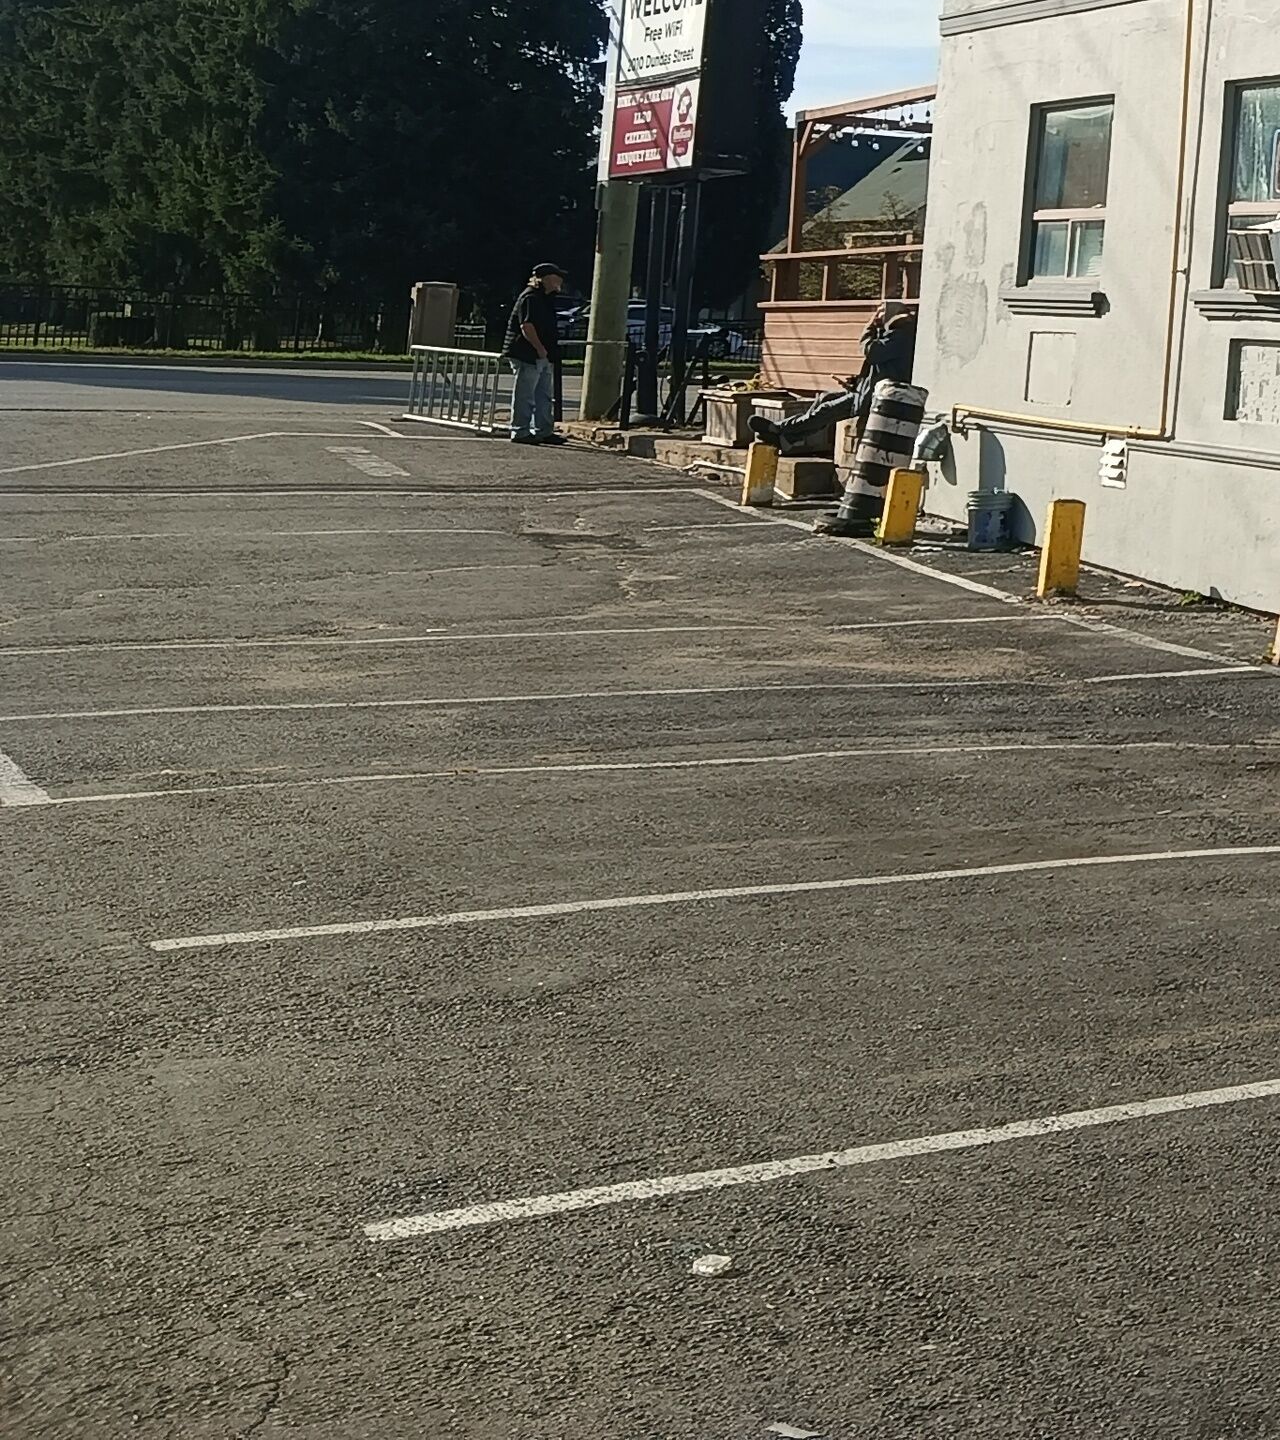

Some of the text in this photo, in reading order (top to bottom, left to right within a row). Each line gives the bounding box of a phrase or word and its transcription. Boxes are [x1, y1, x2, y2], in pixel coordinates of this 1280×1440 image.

[644, 27, 662, 42] Free
[646, 51, 671, 69] Dundas
[673, 46, 694, 63] Street
